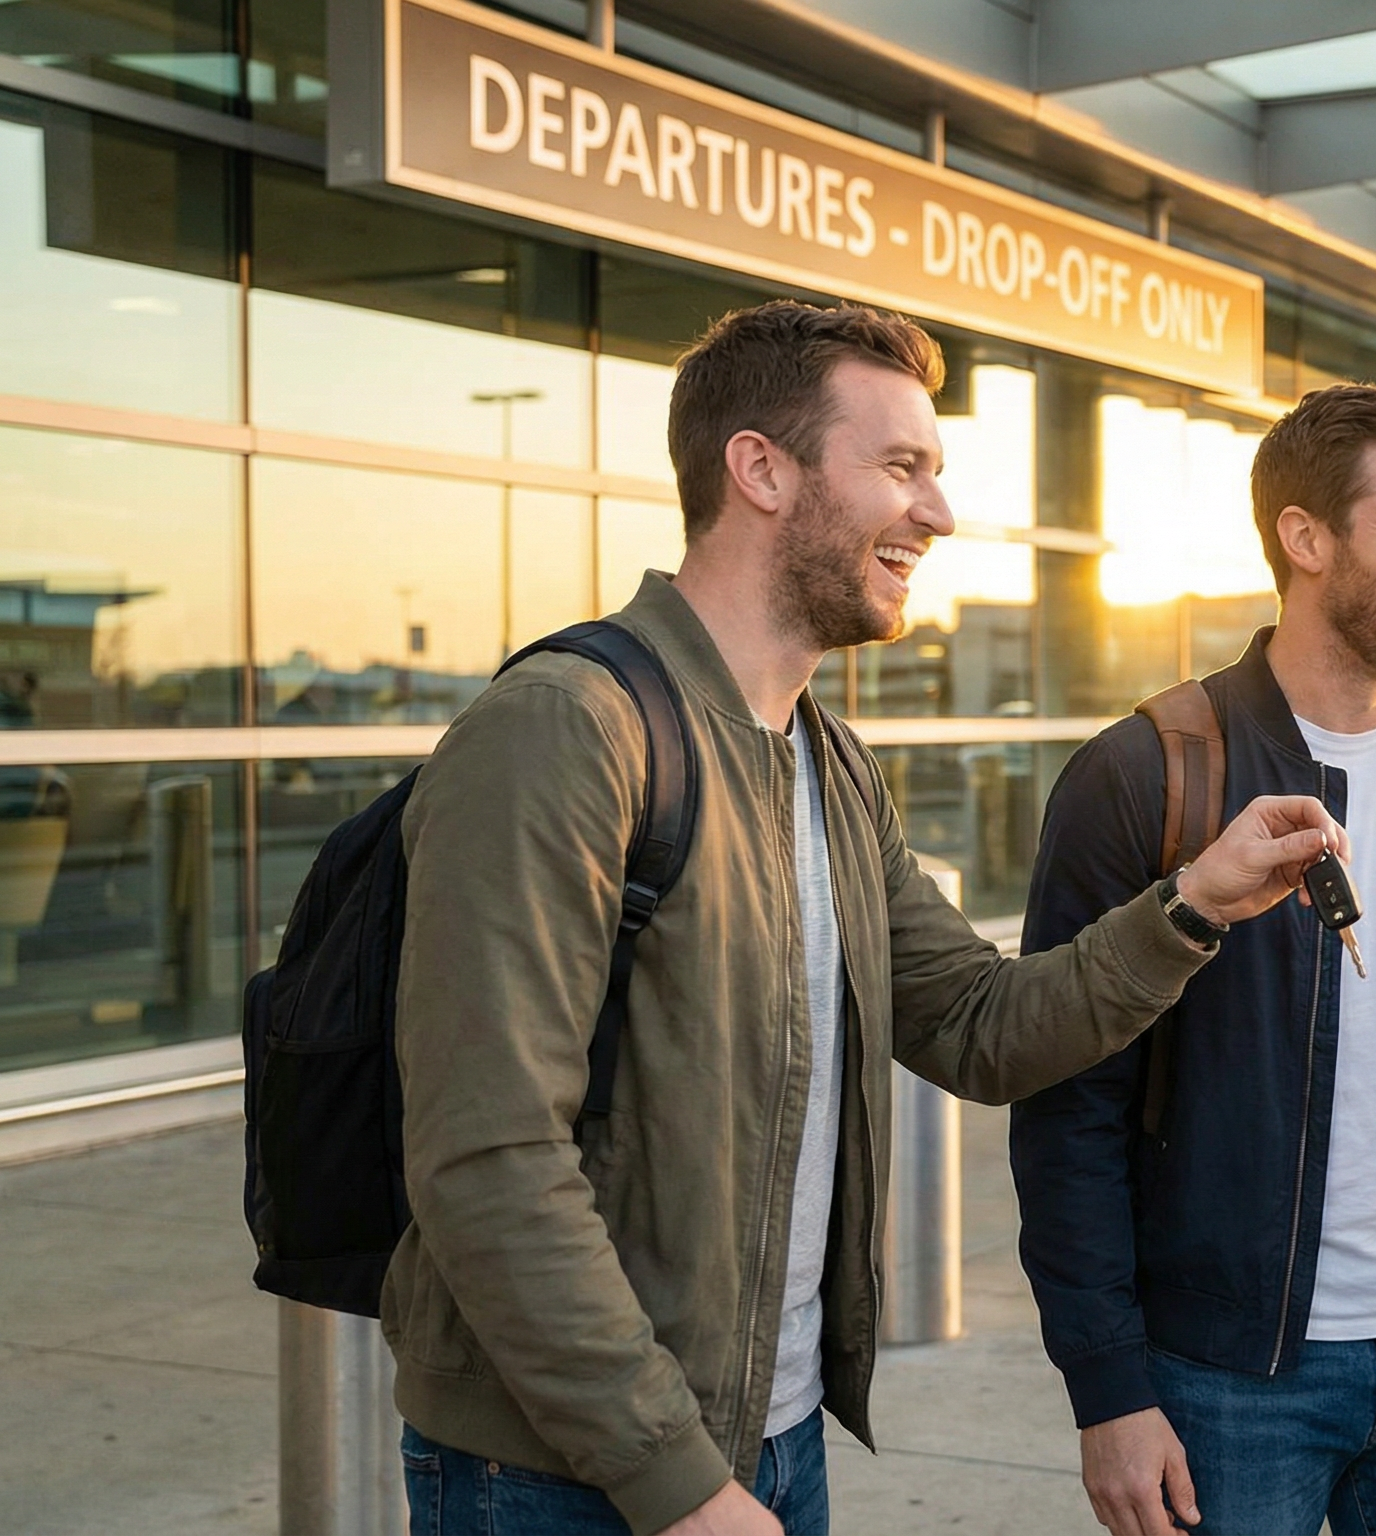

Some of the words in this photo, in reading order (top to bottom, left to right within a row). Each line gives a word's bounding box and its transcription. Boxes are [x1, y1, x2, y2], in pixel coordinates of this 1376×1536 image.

[468, 54, 876, 258] DEPARTURES
[922, 200, 1131, 328] DROP-OFF
[1140, 273, 1230, 355] ONLY
